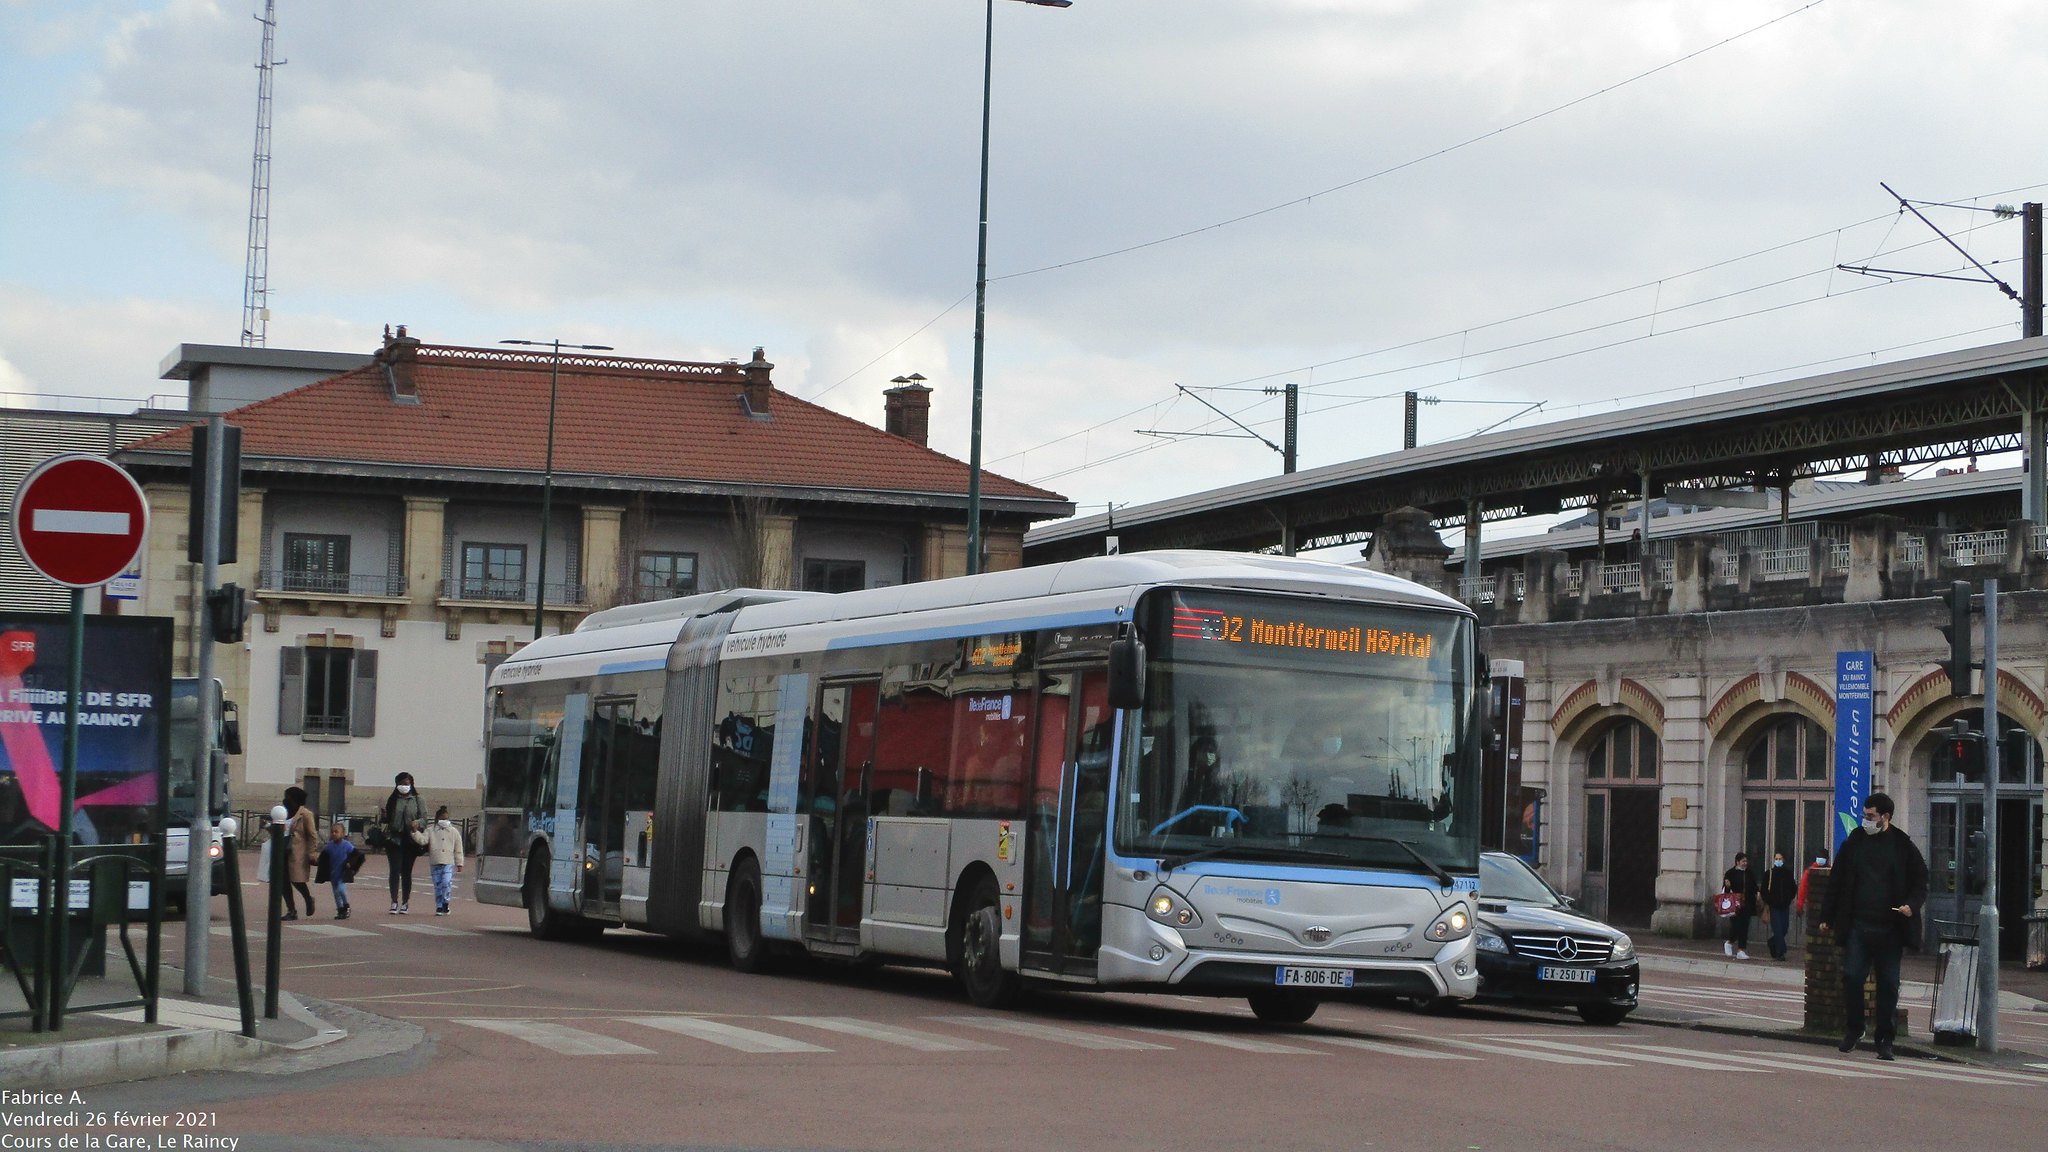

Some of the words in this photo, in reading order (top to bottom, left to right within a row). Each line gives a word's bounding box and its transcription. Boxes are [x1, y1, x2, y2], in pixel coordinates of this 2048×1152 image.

[757, 631, 787, 653] hybride
[1250, 619, 1360, 652] Montfermeil
[1366, 629, 1432, 658] Hôpital
[11, 641, 35, 652] SFR
[1845, 660, 1864, 671] GARE
[1850, 673, 1867, 681] RAINCY
[1838, 682, 1870, 691] VILLEMOMBLE
[86, 691, 112, 706] DE
[116, 692, 153, 708] SFR
[1838, 692, 1870, 700] MONTFERMEIL
[77, 712, 142, 727] RAINCY
[1285, 969, 1344, 985] FA-806-DE
[1543, 967, 1591, 981] EX-250-XT
